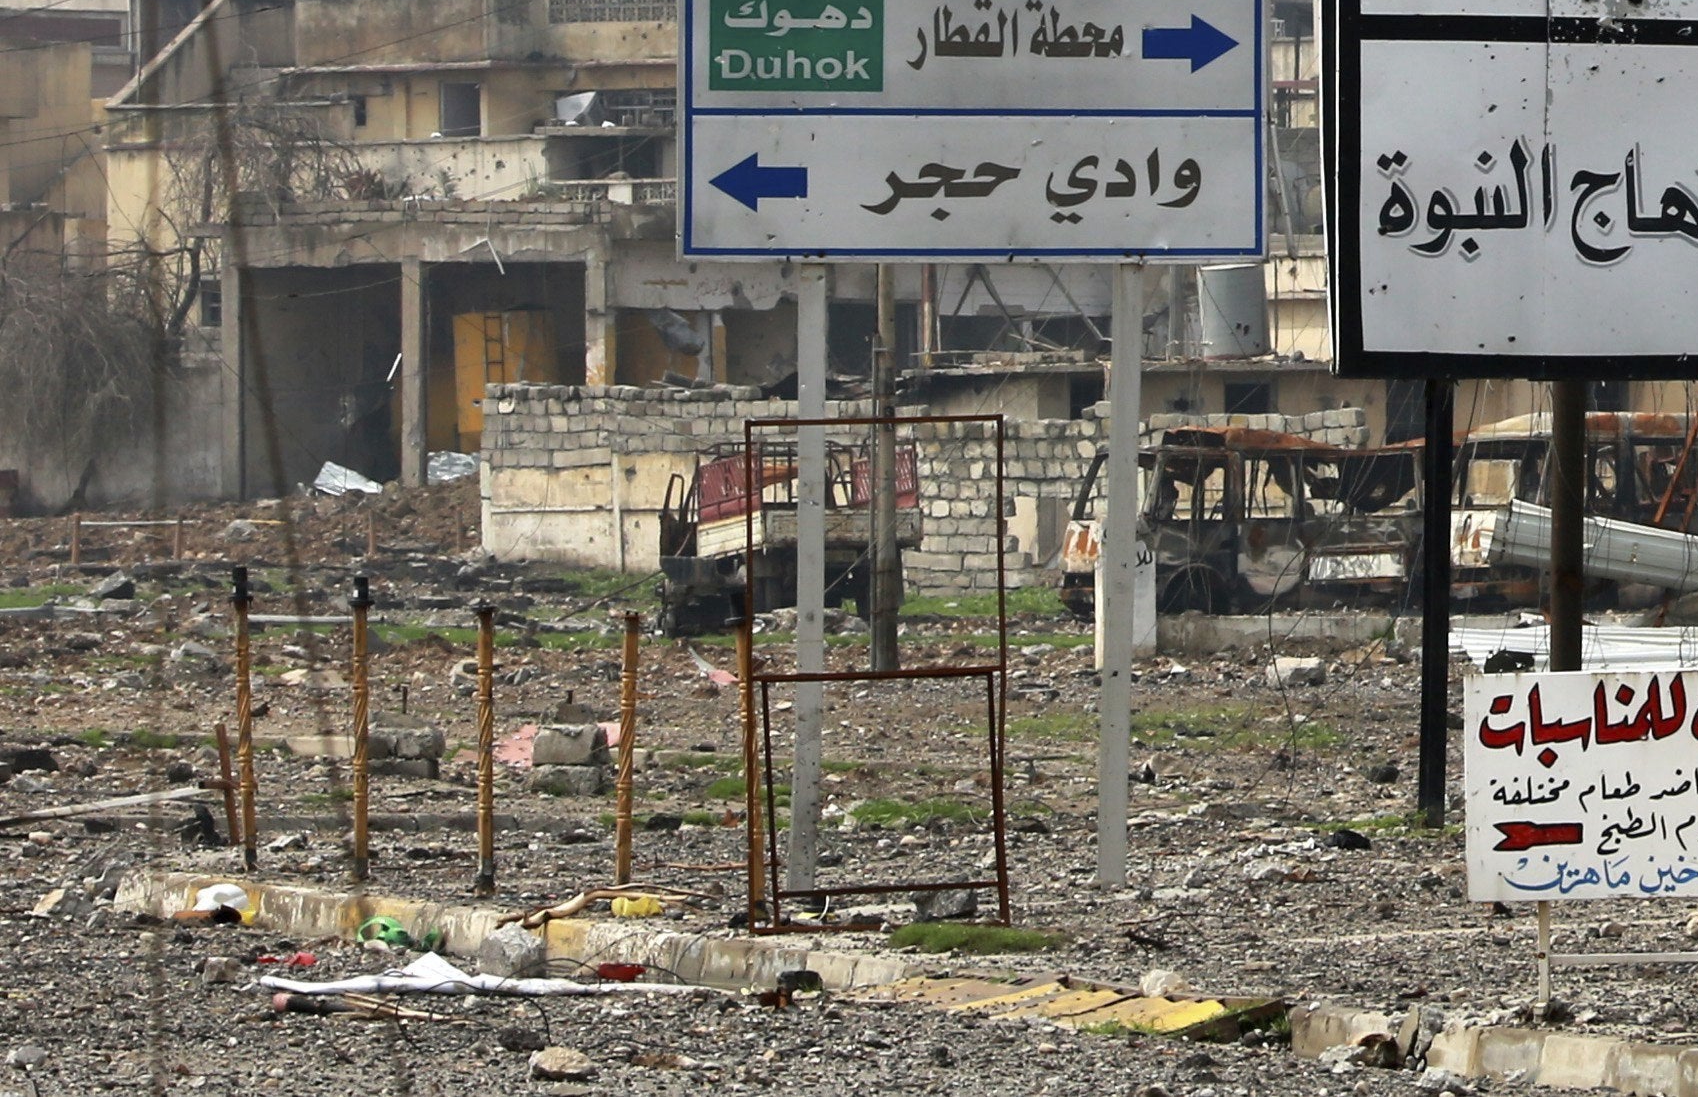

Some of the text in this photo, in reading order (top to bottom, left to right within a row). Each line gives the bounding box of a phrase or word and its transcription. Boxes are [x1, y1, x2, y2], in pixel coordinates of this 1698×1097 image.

[724, 0, 873, 37] دهوك
[721, 49, 870, 80] Duhok
[860, 147, 1202, 224] وادي حجر
[1376, 138, 1555, 256] النبوة
[1478, 671, 1688, 769] للمناسبات
[1489, 775, 1571, 806] مختلفة
[1577, 770, 1642, 813] طعام
[1596, 805, 1668, 856] الطبخ
